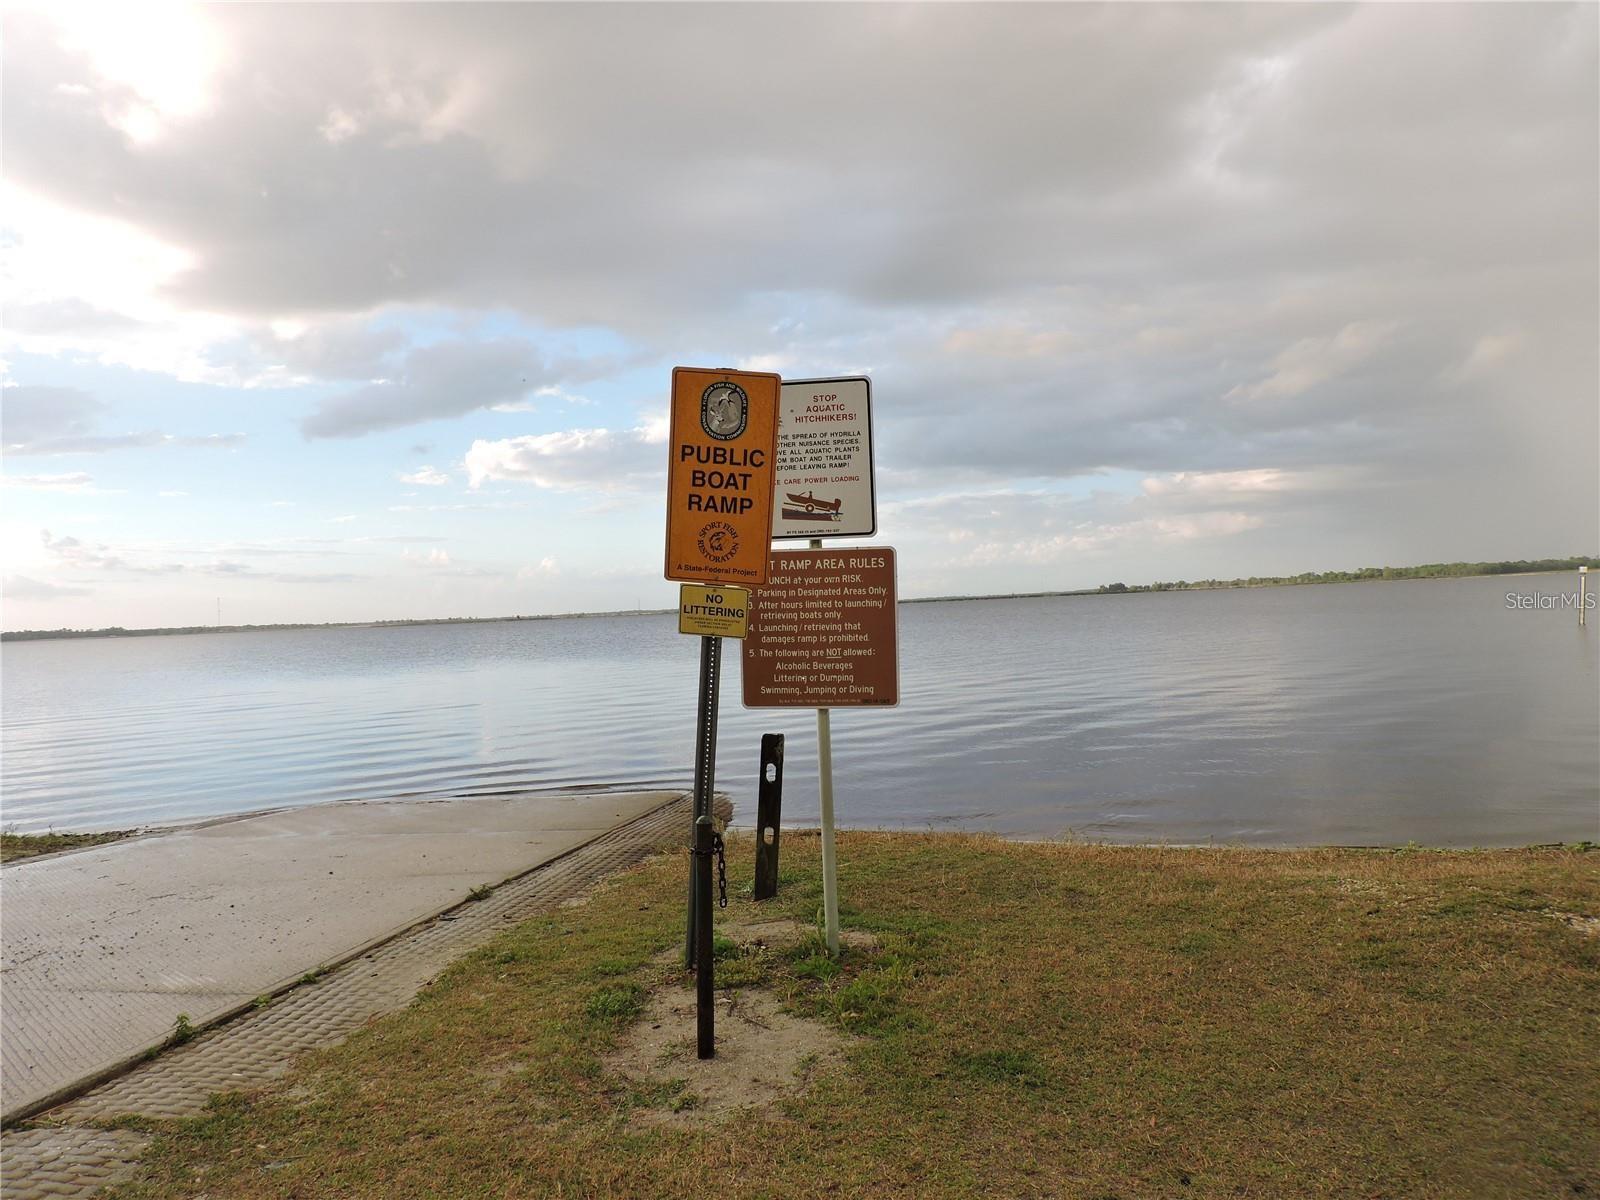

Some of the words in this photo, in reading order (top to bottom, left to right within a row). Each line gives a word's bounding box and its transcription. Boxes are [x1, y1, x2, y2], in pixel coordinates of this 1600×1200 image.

[806, 404, 845, 413] AQUATIC
[795, 413, 857, 423] HITCHHIKERS!
[681, 445, 765, 467] PUBLIC
[691, 470, 752, 490] BOAT
[688, 494, 753, 514] RAMP
[699, 521, 722, 538] SPORT
[723, 523, 739, 539] FISH
[780, 560, 811, 570] RAMP
[815, 559, 845, 569] AREA
[850, 558, 885, 568] RULES
[684, 565, 730, 574] State-Federal
[733, 568, 757, 576] Project
[768, 577, 791, 585] UNCH
[793, 576, 801, 584] at
[804, 576, 822, 586] your
[758, 590, 786, 599] Parking
[798, 587, 841, 598] Designated
[843, 587, 867, 595] Areas
[706, 594, 723, 604] NO
[759, 601, 778, 609] After
[781, 601, 803, 609] hours
[805, 600, 832, 608] limited
[835, 600, 843, 608] to
[845, 599, 882, 609] launching
[683, 605, 744, 618] LITTERING
[760, 612, 798, 621] retrieving
[800, 611, 822, 619] boats
[759, 624, 798, 633] Launching
[804, 623, 841, 632] retrieving
[844, 622, 861, 631] that
[761, 635, 795, 644] damages
[798, 636, 817, 644] ramp
[759, 649, 773, 657] The
[775, 649, 809, 658] following
[826, 648, 841, 657] NOT
[843, 648, 876, 656] allowed:
[776, 662, 810, 670] Alcoholic
[813, 662, 853, 671] Beverages
[774, 674, 807, 683] Littering
[820, 674, 854, 683] Dumping
[760, 686, 802, 695] Swimming,
[804, 686, 837, 695] Jumping
[849, 685, 874, 695] Diving
